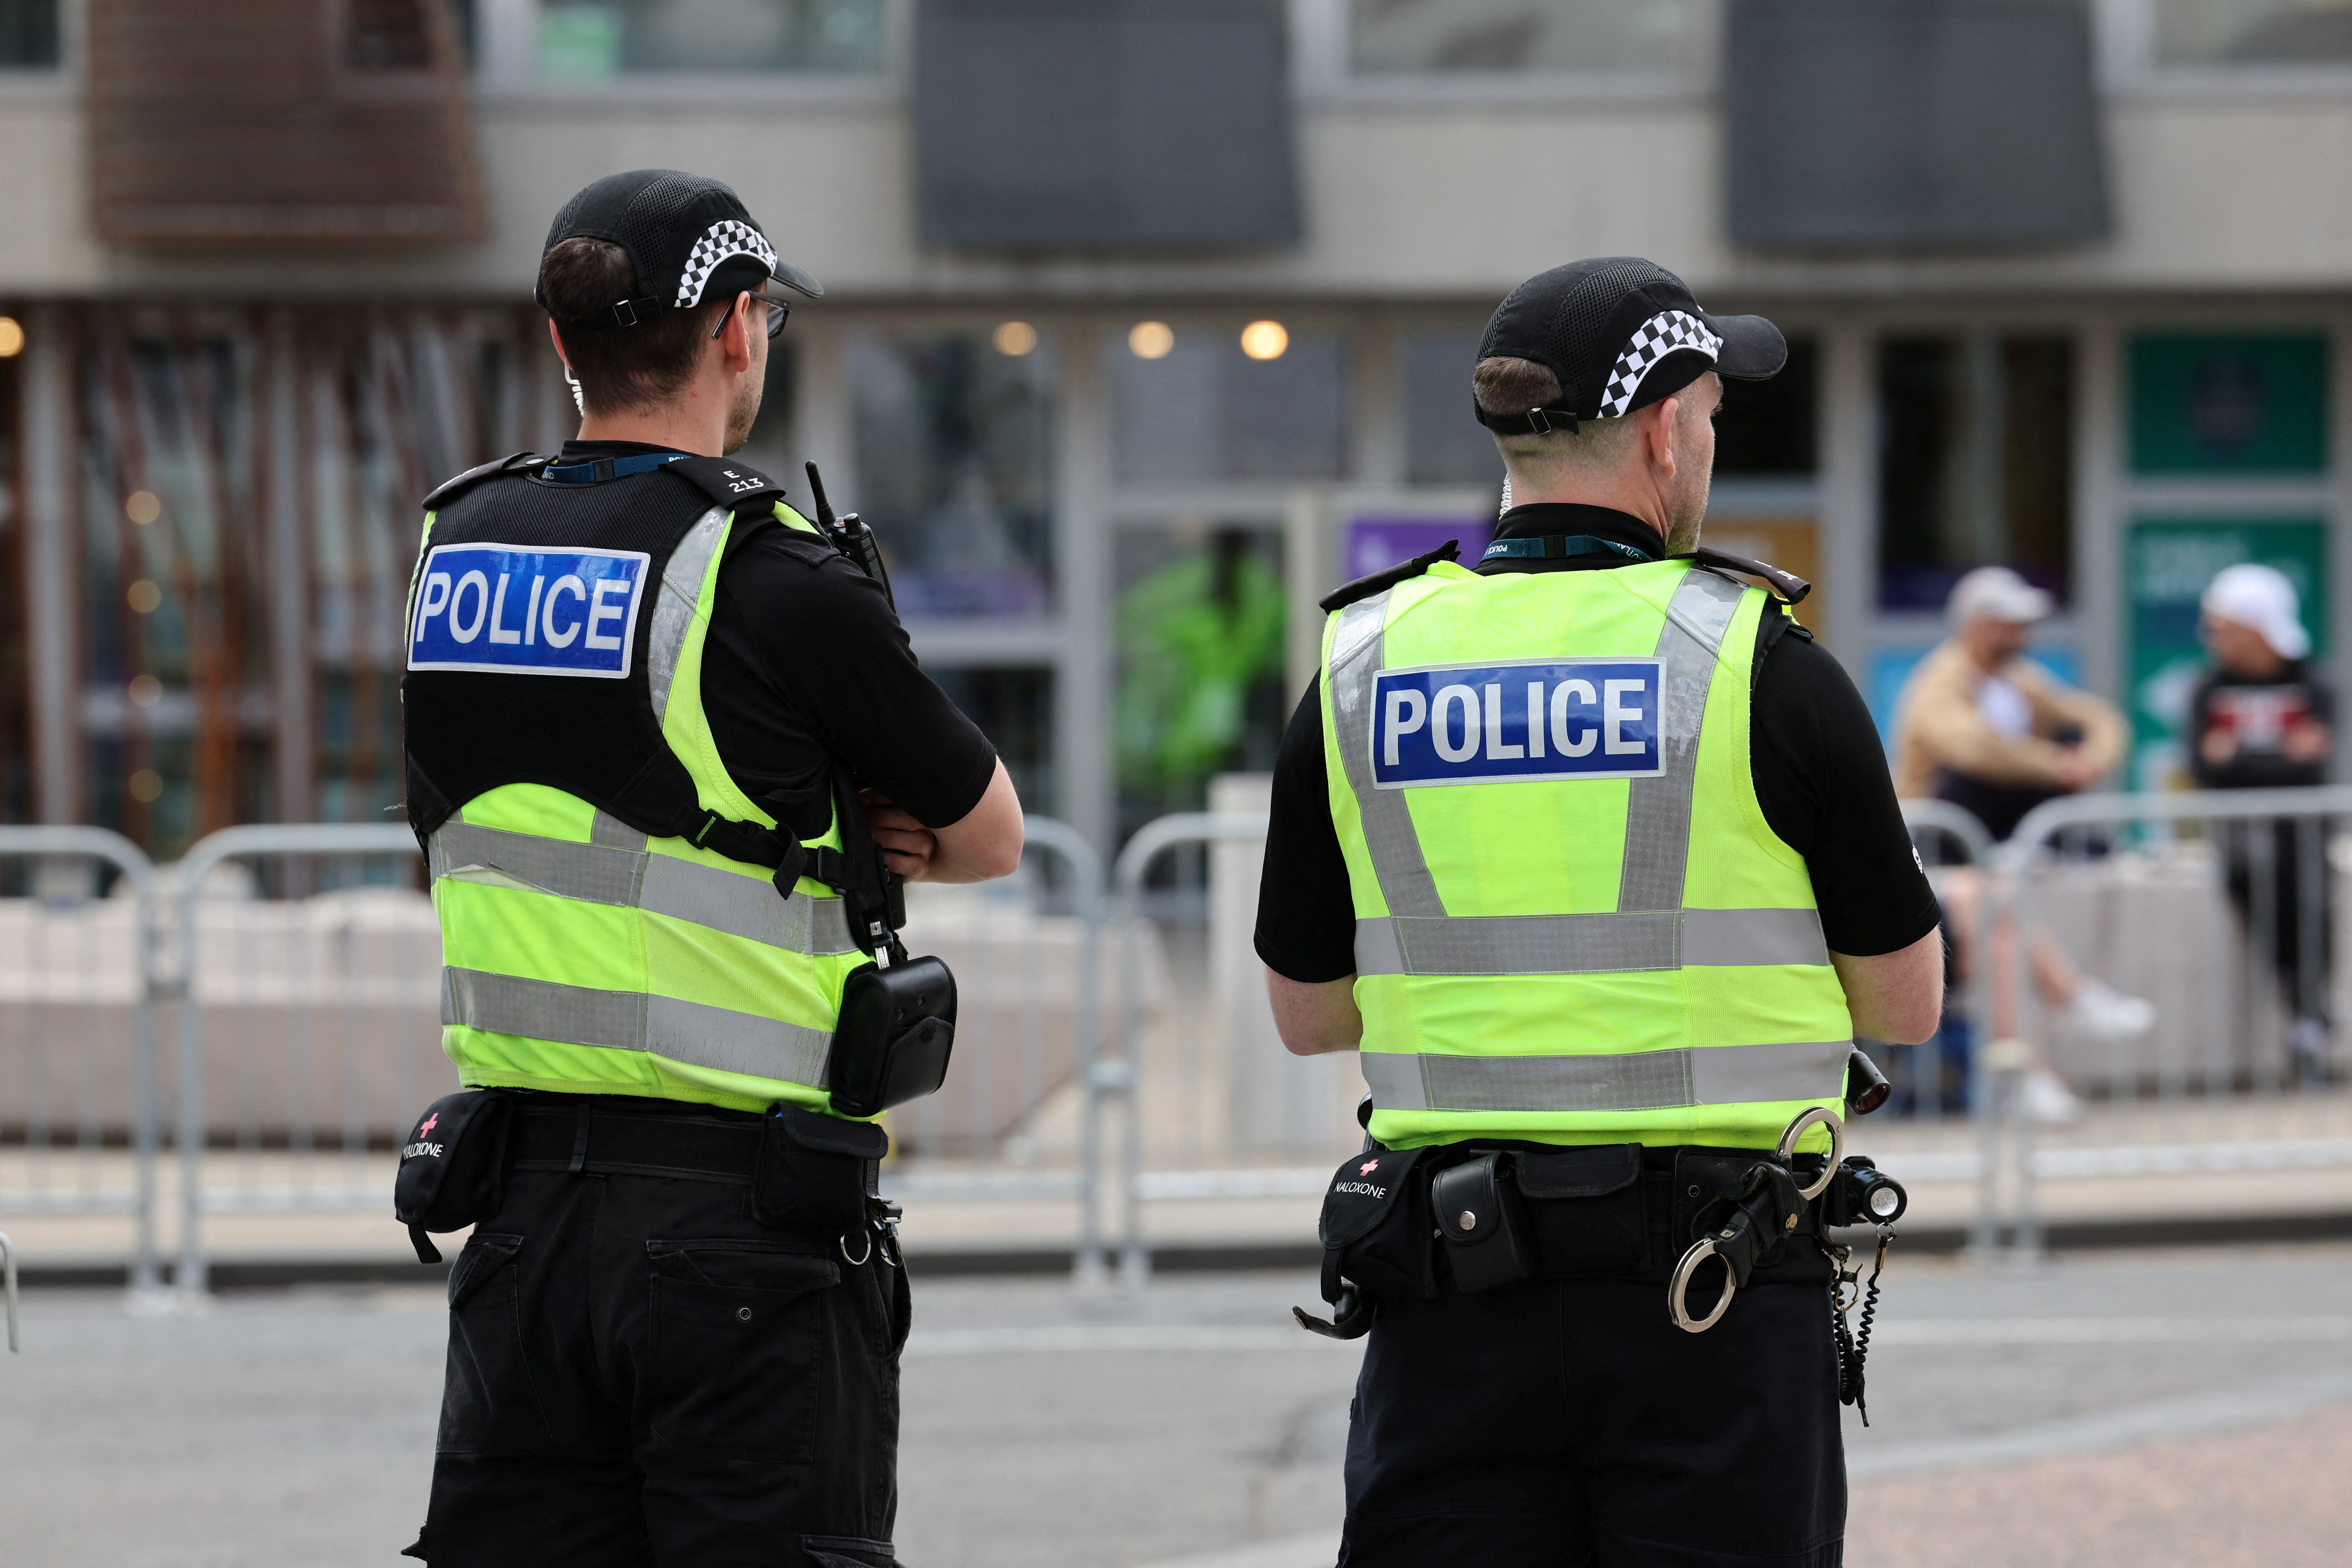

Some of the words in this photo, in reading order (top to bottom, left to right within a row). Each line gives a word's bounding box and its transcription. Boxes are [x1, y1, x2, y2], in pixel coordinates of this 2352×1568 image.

[729, 477, 764, 492] 213
[1487, 544, 1507, 555] POLICE
[416, 570, 631, 650] POLICE
[1384, 679, 1646, 766] POLICE
[403, 1142, 443, 1160] NALOXONE
[1334, 1181, 1387, 1199] NALOXONE
